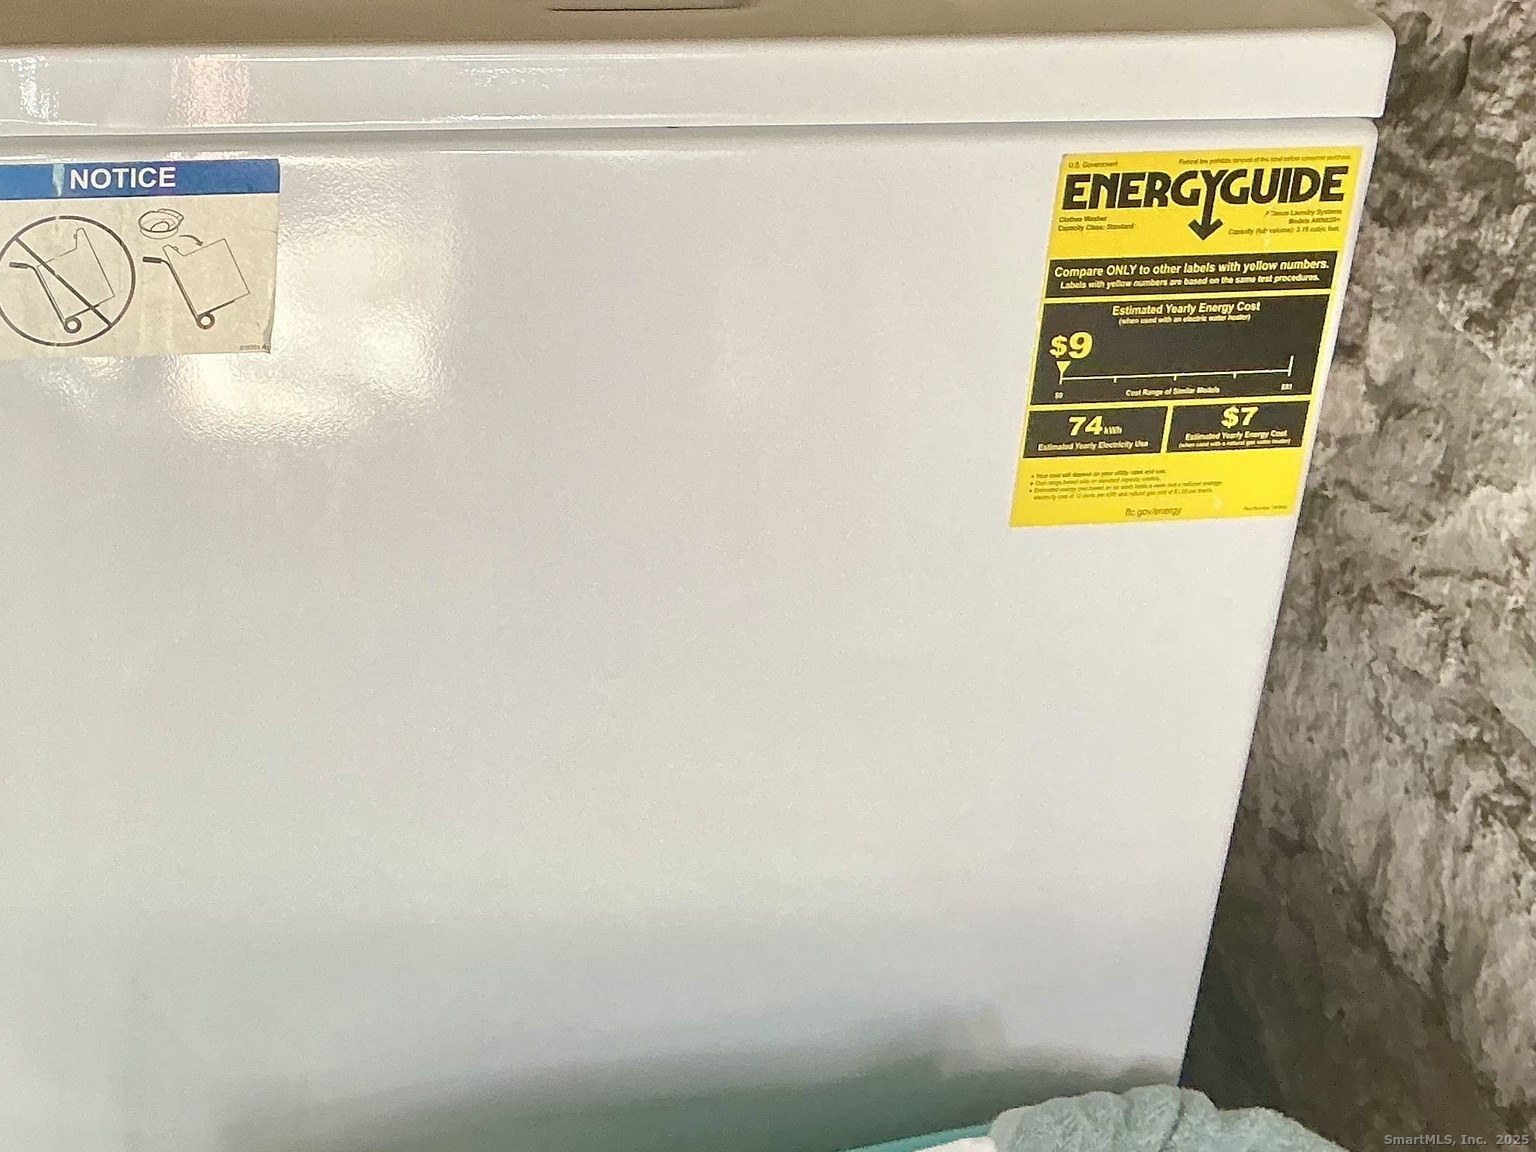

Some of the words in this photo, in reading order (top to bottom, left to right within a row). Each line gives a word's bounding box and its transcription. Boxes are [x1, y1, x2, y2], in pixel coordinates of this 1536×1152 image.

[69, 166, 176, 190] NOTICE
[1061, 165, 1350, 212] ENERGYGUIDE
[1054, 266, 1104, 279] Compare
[1106, 264, 1139, 276] ONLY
[1139, 264, 1150, 275] to
[1152, 263, 1182, 274] other
[1183, 262, 1216, 274] labels
[1218, 261, 1241, 272] with
[1242, 260, 1278, 274] yellow
[1280, 258, 1330, 270] numbers.
[1060, 281, 1087, 290] Labels
[1088, 280, 1105, 288] with
[1106, 279, 1132, 290] yellow
[1133, 277, 1168, 287] numbers
[1169, 278, 1182, 286] are
[1183, 277, 1207, 286] based
[1221, 276, 1233, 284] the
[1235, 276, 1256, 284] same
[1257, 275, 1273, 283] test
[1273, 273, 1320, 284] procedures.
[1112, 304, 1163, 316] Estimated
[1165, 303, 1197, 315] Yearly
[1198, 301, 1235, 314] Energy
[1236, 300, 1261, 311] Cost
[1049, 331, 1093, 359] $9
[1125, 389, 1141, 397] Cost
[1142, 388, 1164, 397] Range
[1164, 387, 1172, 395] of
[1172, 386, 1196, 395] Similar
[1196, 386, 1220, 394] Models
[1068, 415, 1103, 436] 74
[1104, 425, 1123, 435] kWh
[1221, 405, 1259, 428] $7
[1038, 443, 1074, 452] Estimated
[1075, 441, 1097, 451] Yearly
[1098, 440, 1133, 450] Electricity
[1134, 439, 1149, 447] Use
[1185, 432, 1221, 441] Estimated
[1222, 431, 1243, 440] Yearly
[1244, 430, 1270, 440] Energy
[1270, 429, 1288, 437] Cost
